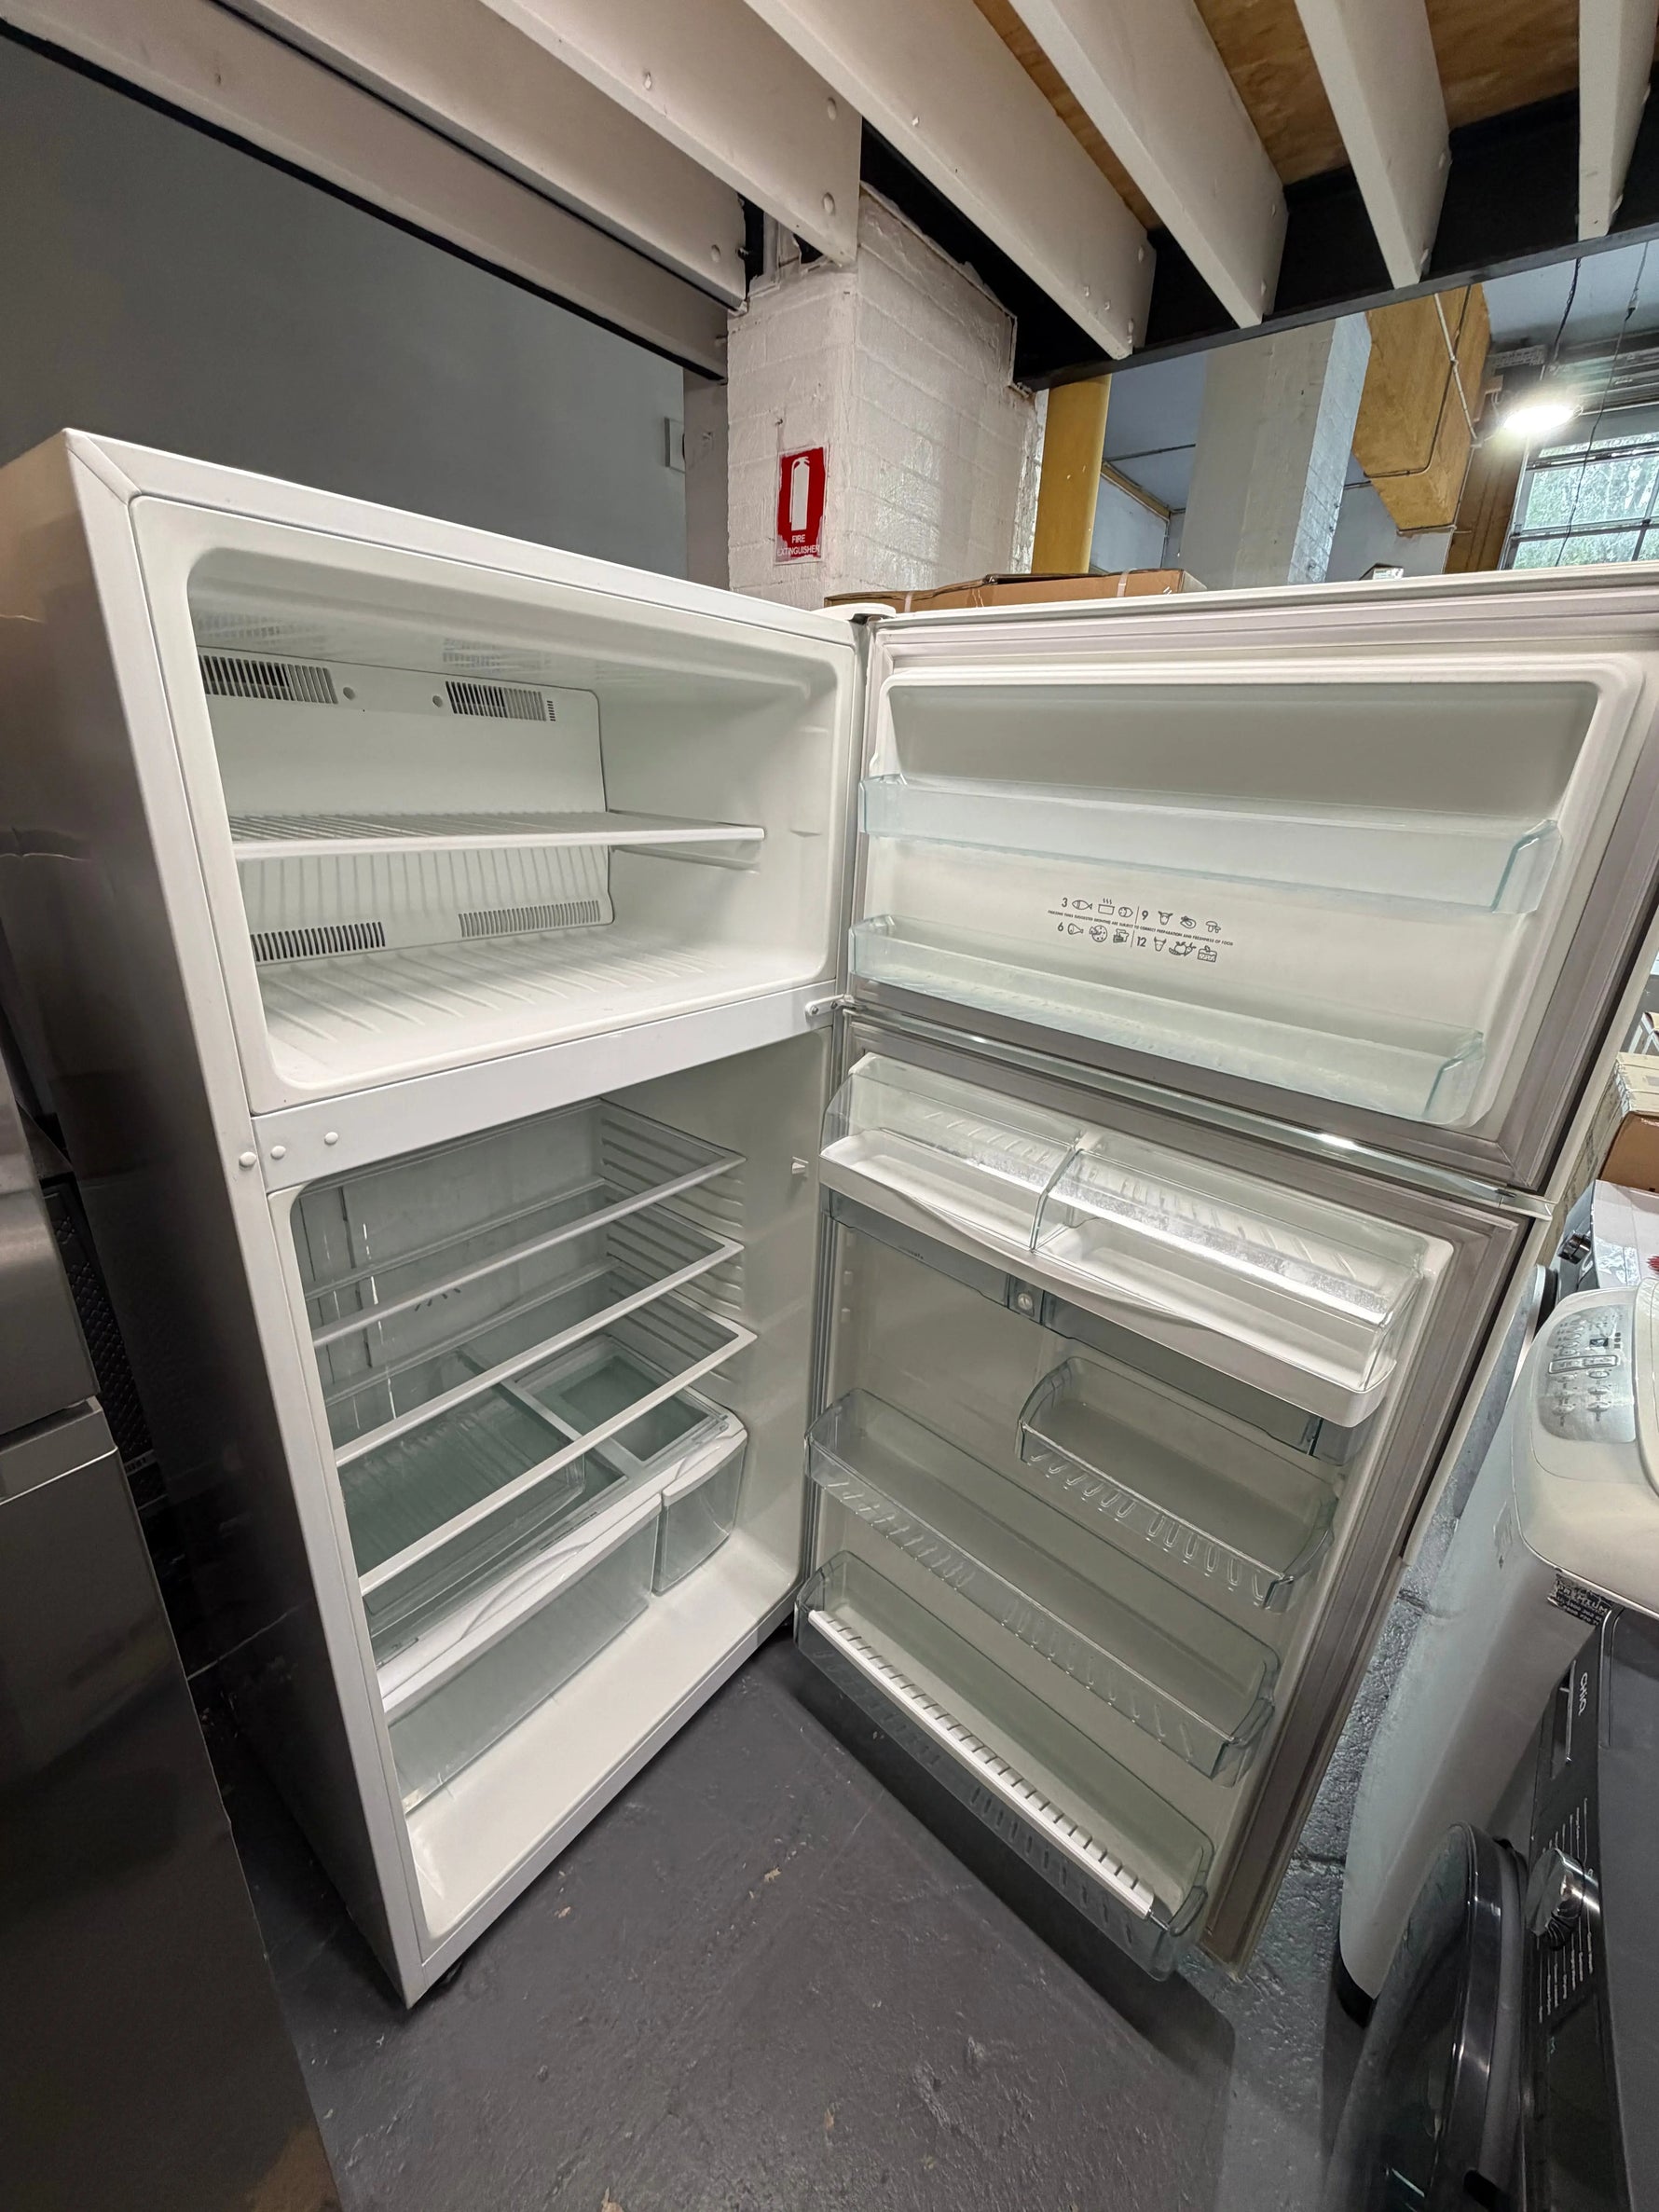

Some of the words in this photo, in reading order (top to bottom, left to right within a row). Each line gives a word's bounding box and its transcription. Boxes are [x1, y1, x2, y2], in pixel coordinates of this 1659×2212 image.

[791, 534, 806, 543] FIRE
[777, 545, 820, 556] EXTINGUISHER
[1061, 897, 1068, 908] 3
[1141, 910, 1149, 920] 9
[1057, 921, 1064, 932] 6
[1136, 936, 1147, 948] 12
